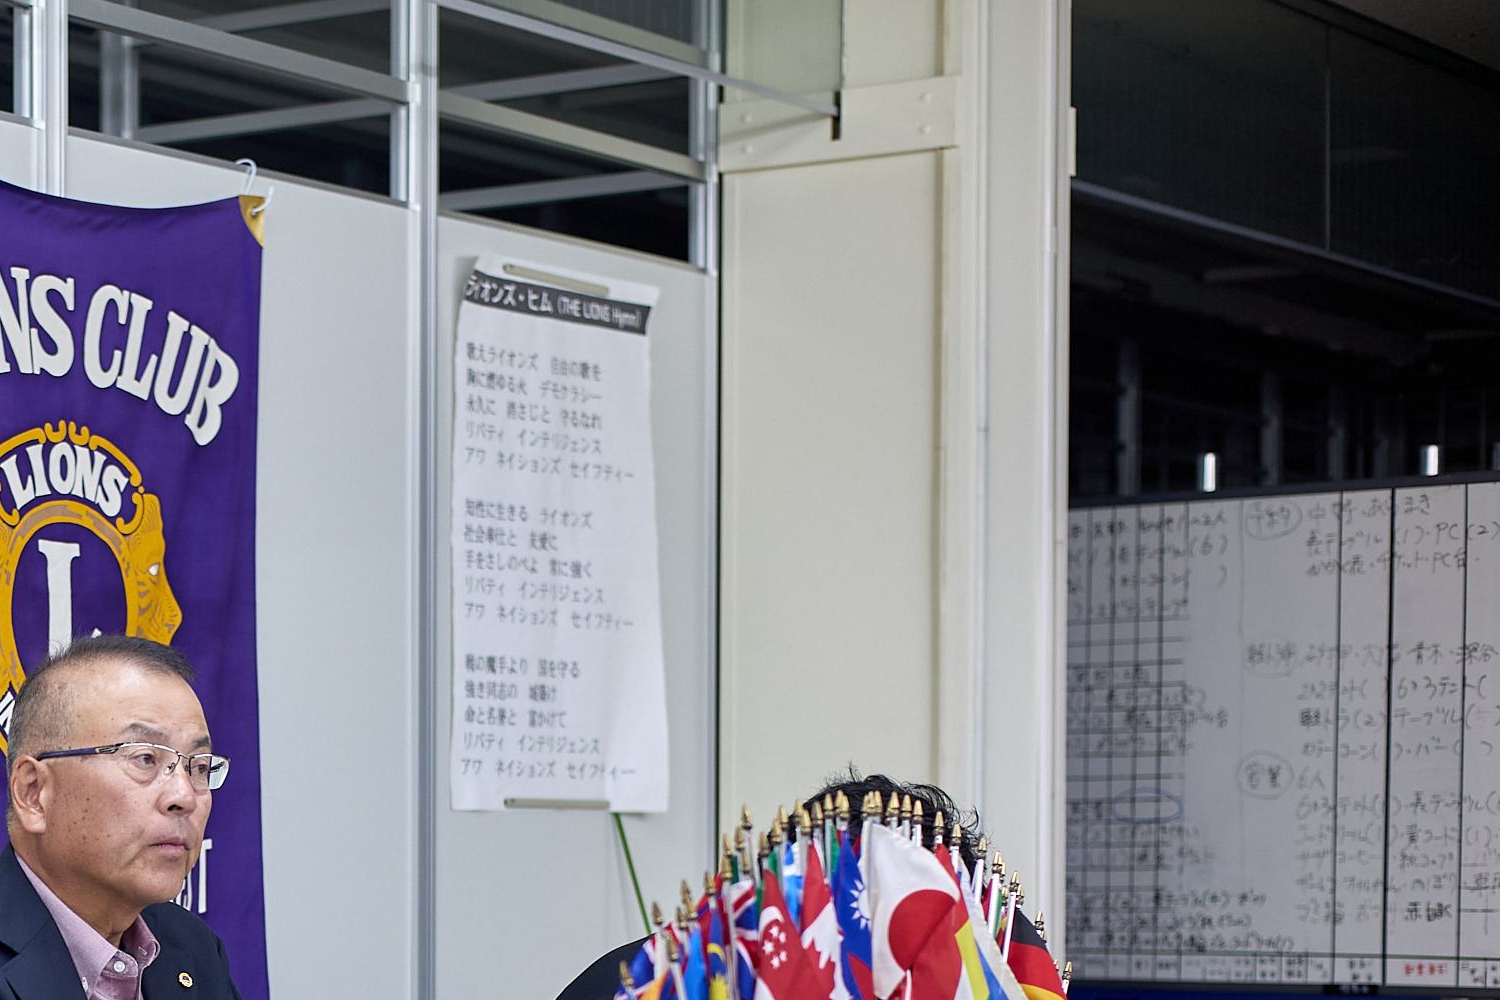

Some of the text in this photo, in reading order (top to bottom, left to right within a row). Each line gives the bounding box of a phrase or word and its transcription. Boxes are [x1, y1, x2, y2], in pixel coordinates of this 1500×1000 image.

[83, 284, 239, 446] CLUB
[538, 380, 602, 404] デモクラシー
[0, 441, 128, 517] LIONS
[539, 506, 593, 529] ライオンズ
